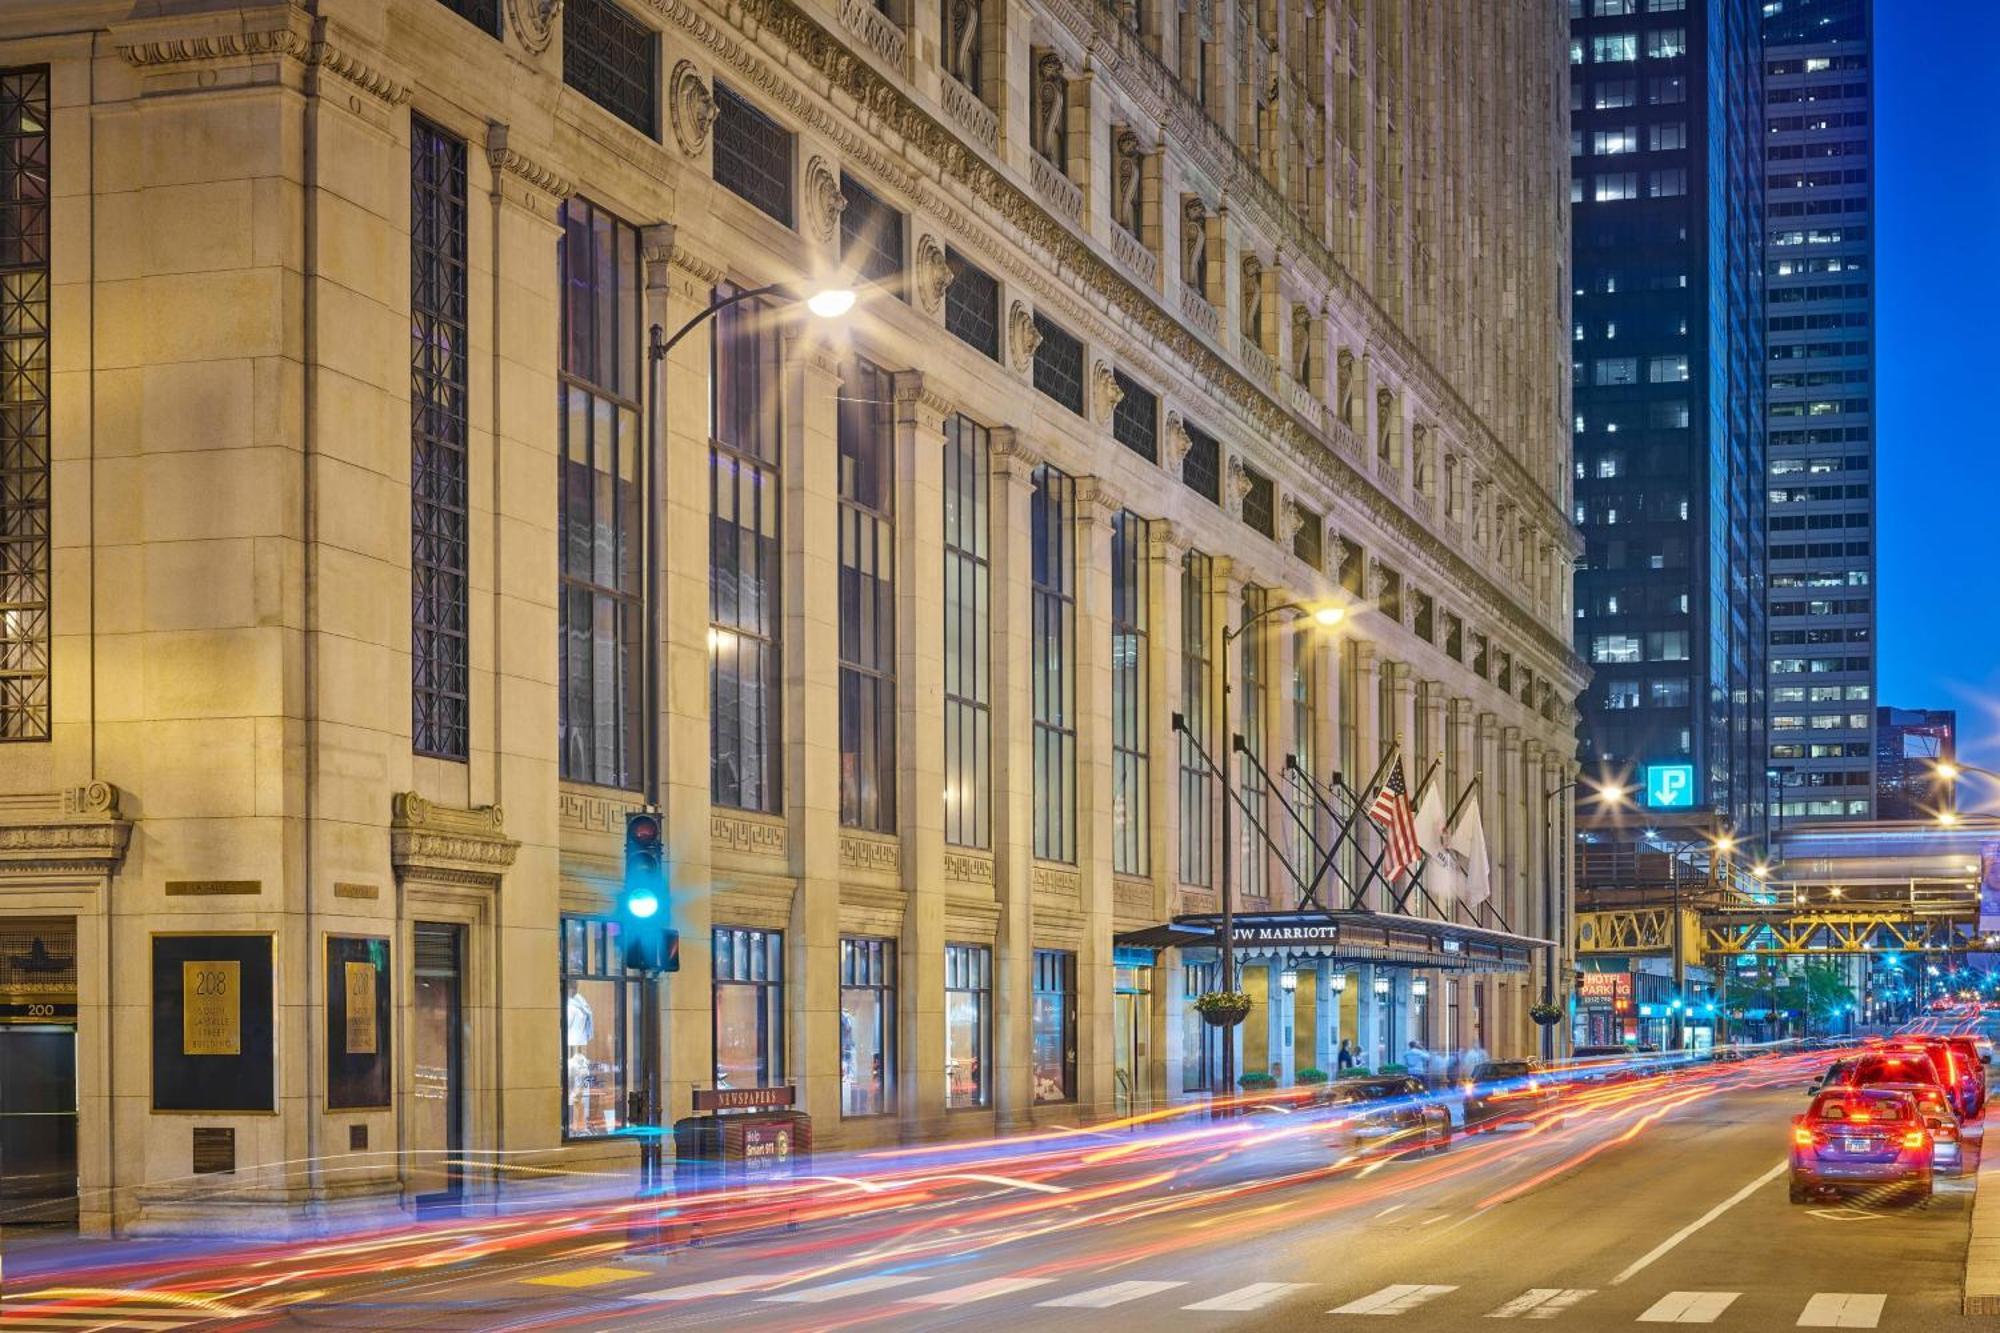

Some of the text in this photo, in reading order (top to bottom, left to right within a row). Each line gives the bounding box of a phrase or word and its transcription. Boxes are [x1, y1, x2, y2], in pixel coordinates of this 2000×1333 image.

[1232, 927, 1337, 941] JW MARRIOTT
[196, 971, 226, 996] 208
[1587, 974, 1623, 984] HOTEL
[1582, 984, 1630, 995] PARKING
[28, 1004, 54, 1016] 200
[719, 1089, 777, 1107] NEWSPAPERS
